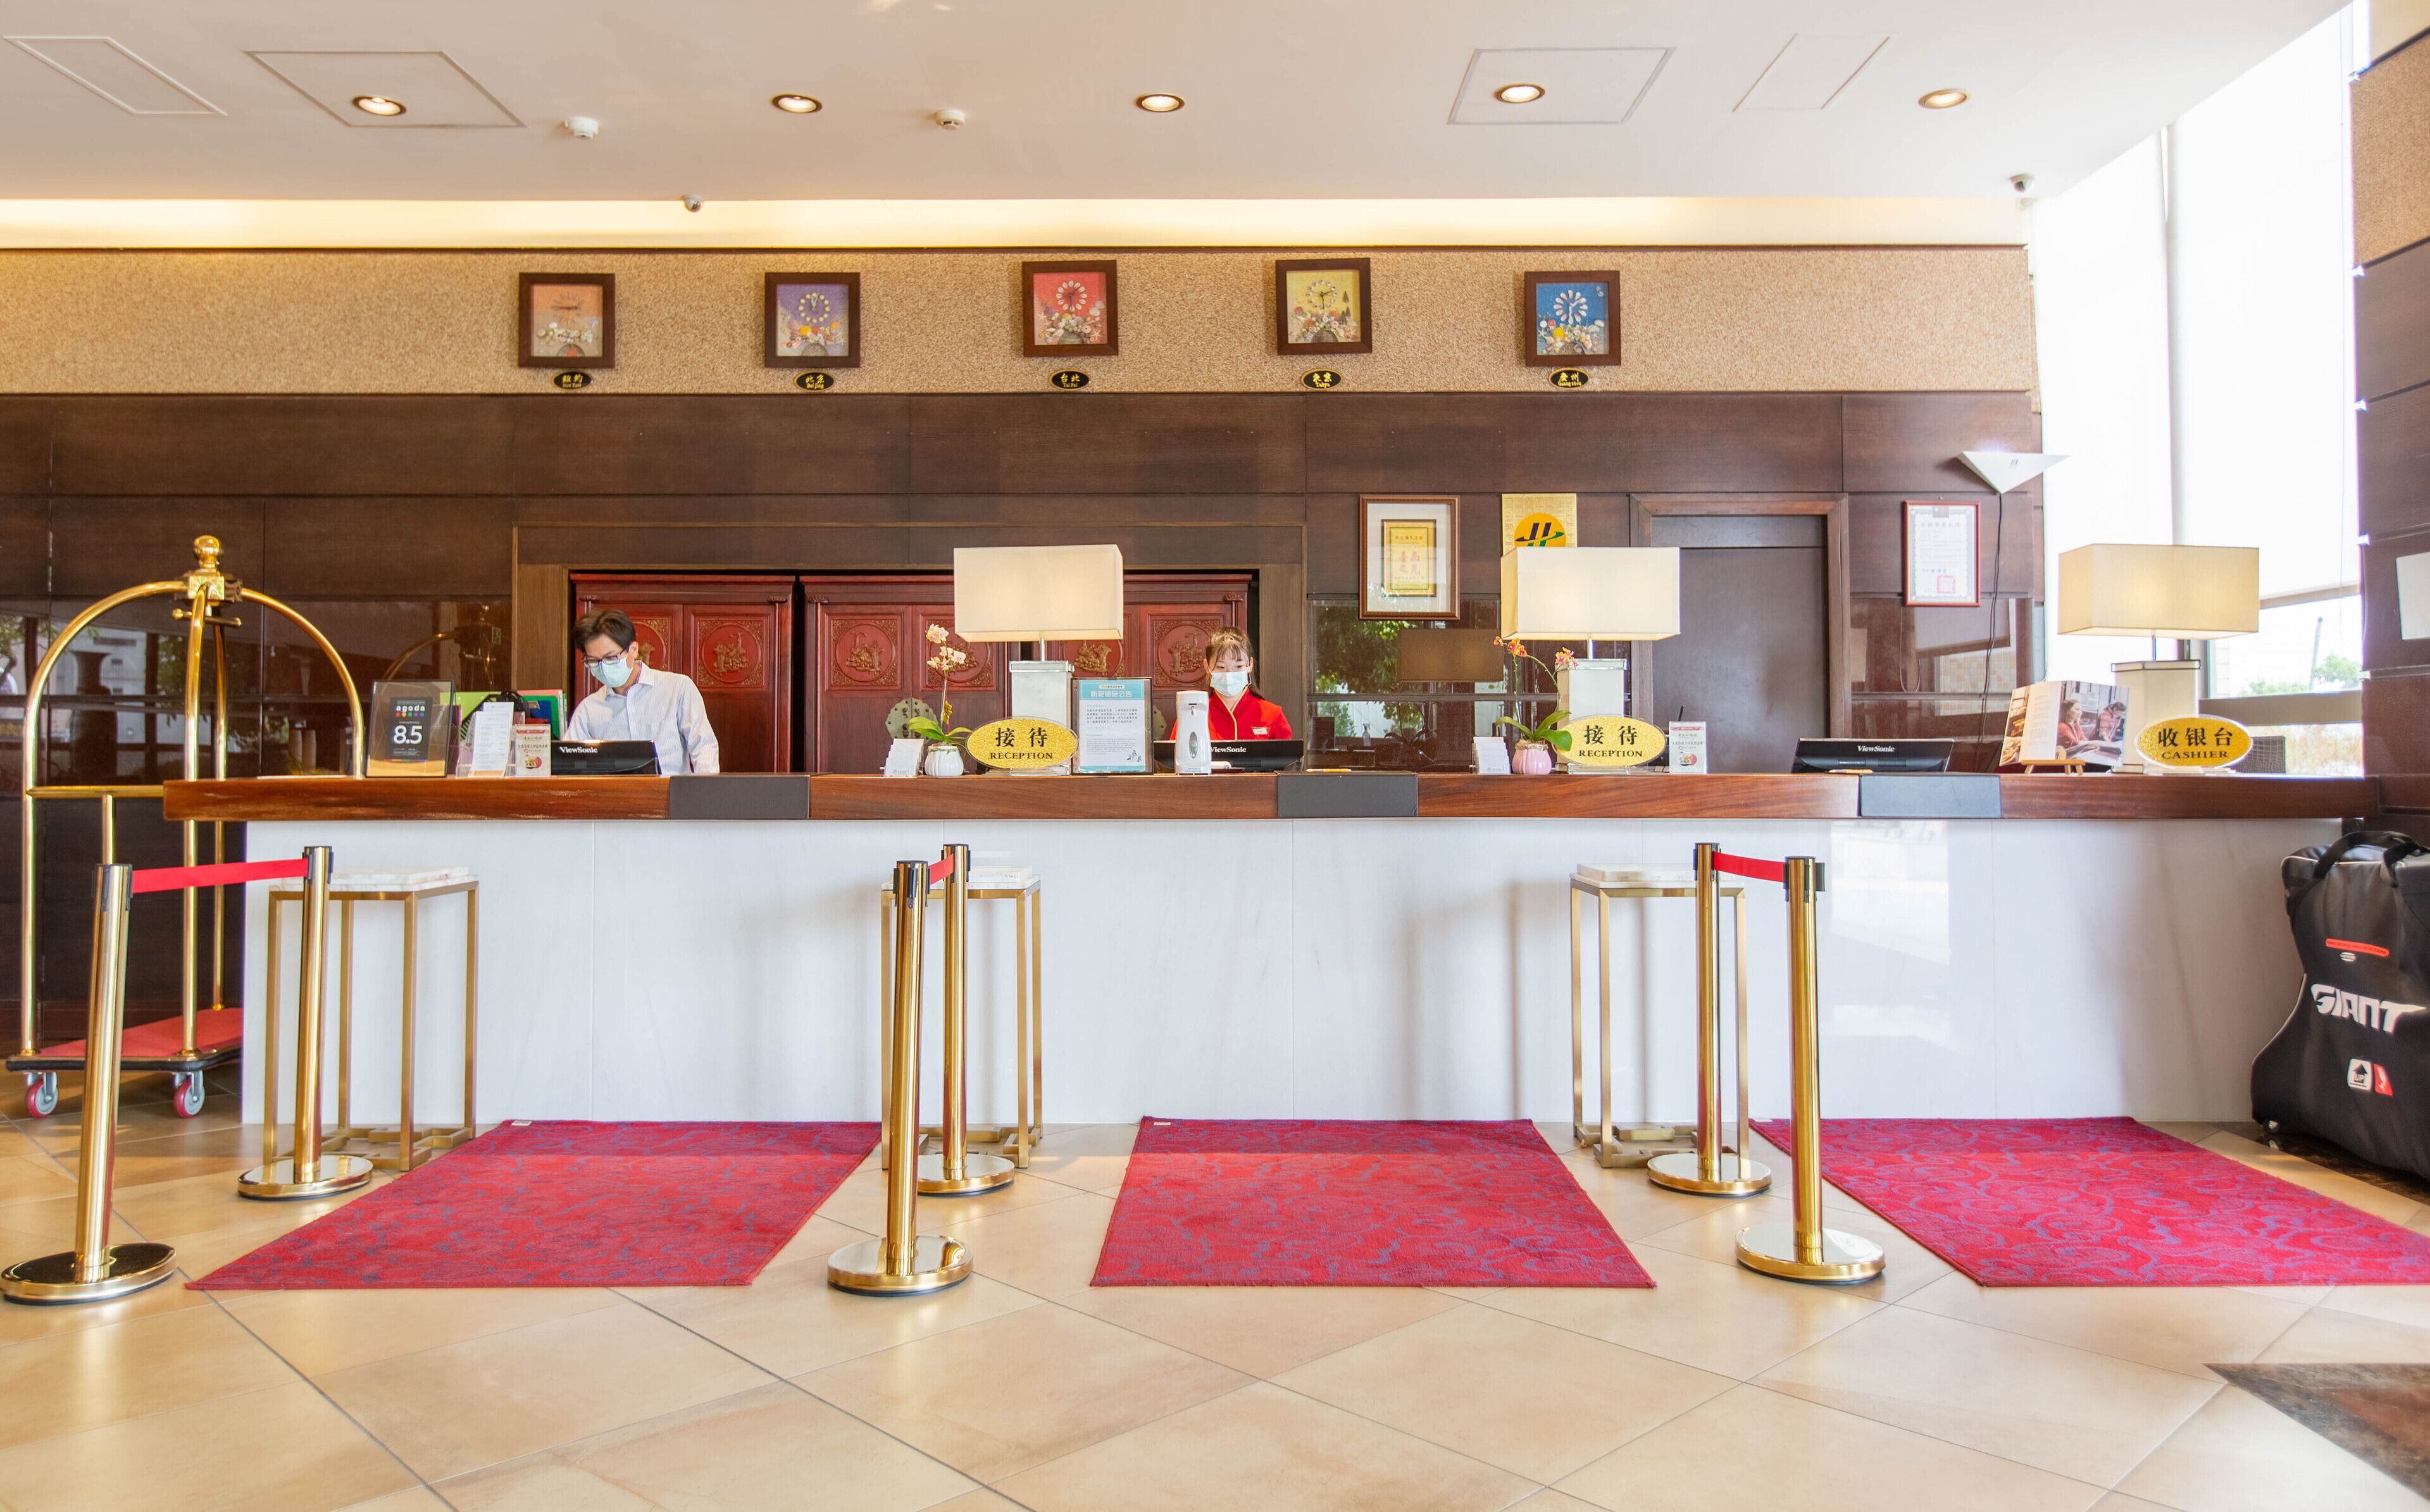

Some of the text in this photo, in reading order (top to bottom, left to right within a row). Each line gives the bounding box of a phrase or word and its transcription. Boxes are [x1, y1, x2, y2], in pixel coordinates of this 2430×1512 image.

[806, 375, 825, 383] 北京
[1061, 373, 1080, 382] 台北
[396, 704, 425, 712] agoda
[394, 725, 423, 745] 8.5
[995, 728, 1047, 747] 接待
[1584, 725, 1638, 745] 接待
[2158, 728, 2233, 747] 收银台
[2162, 751, 2228, 759] CASHIER
[2311, 984, 2427, 1034] GIANT
